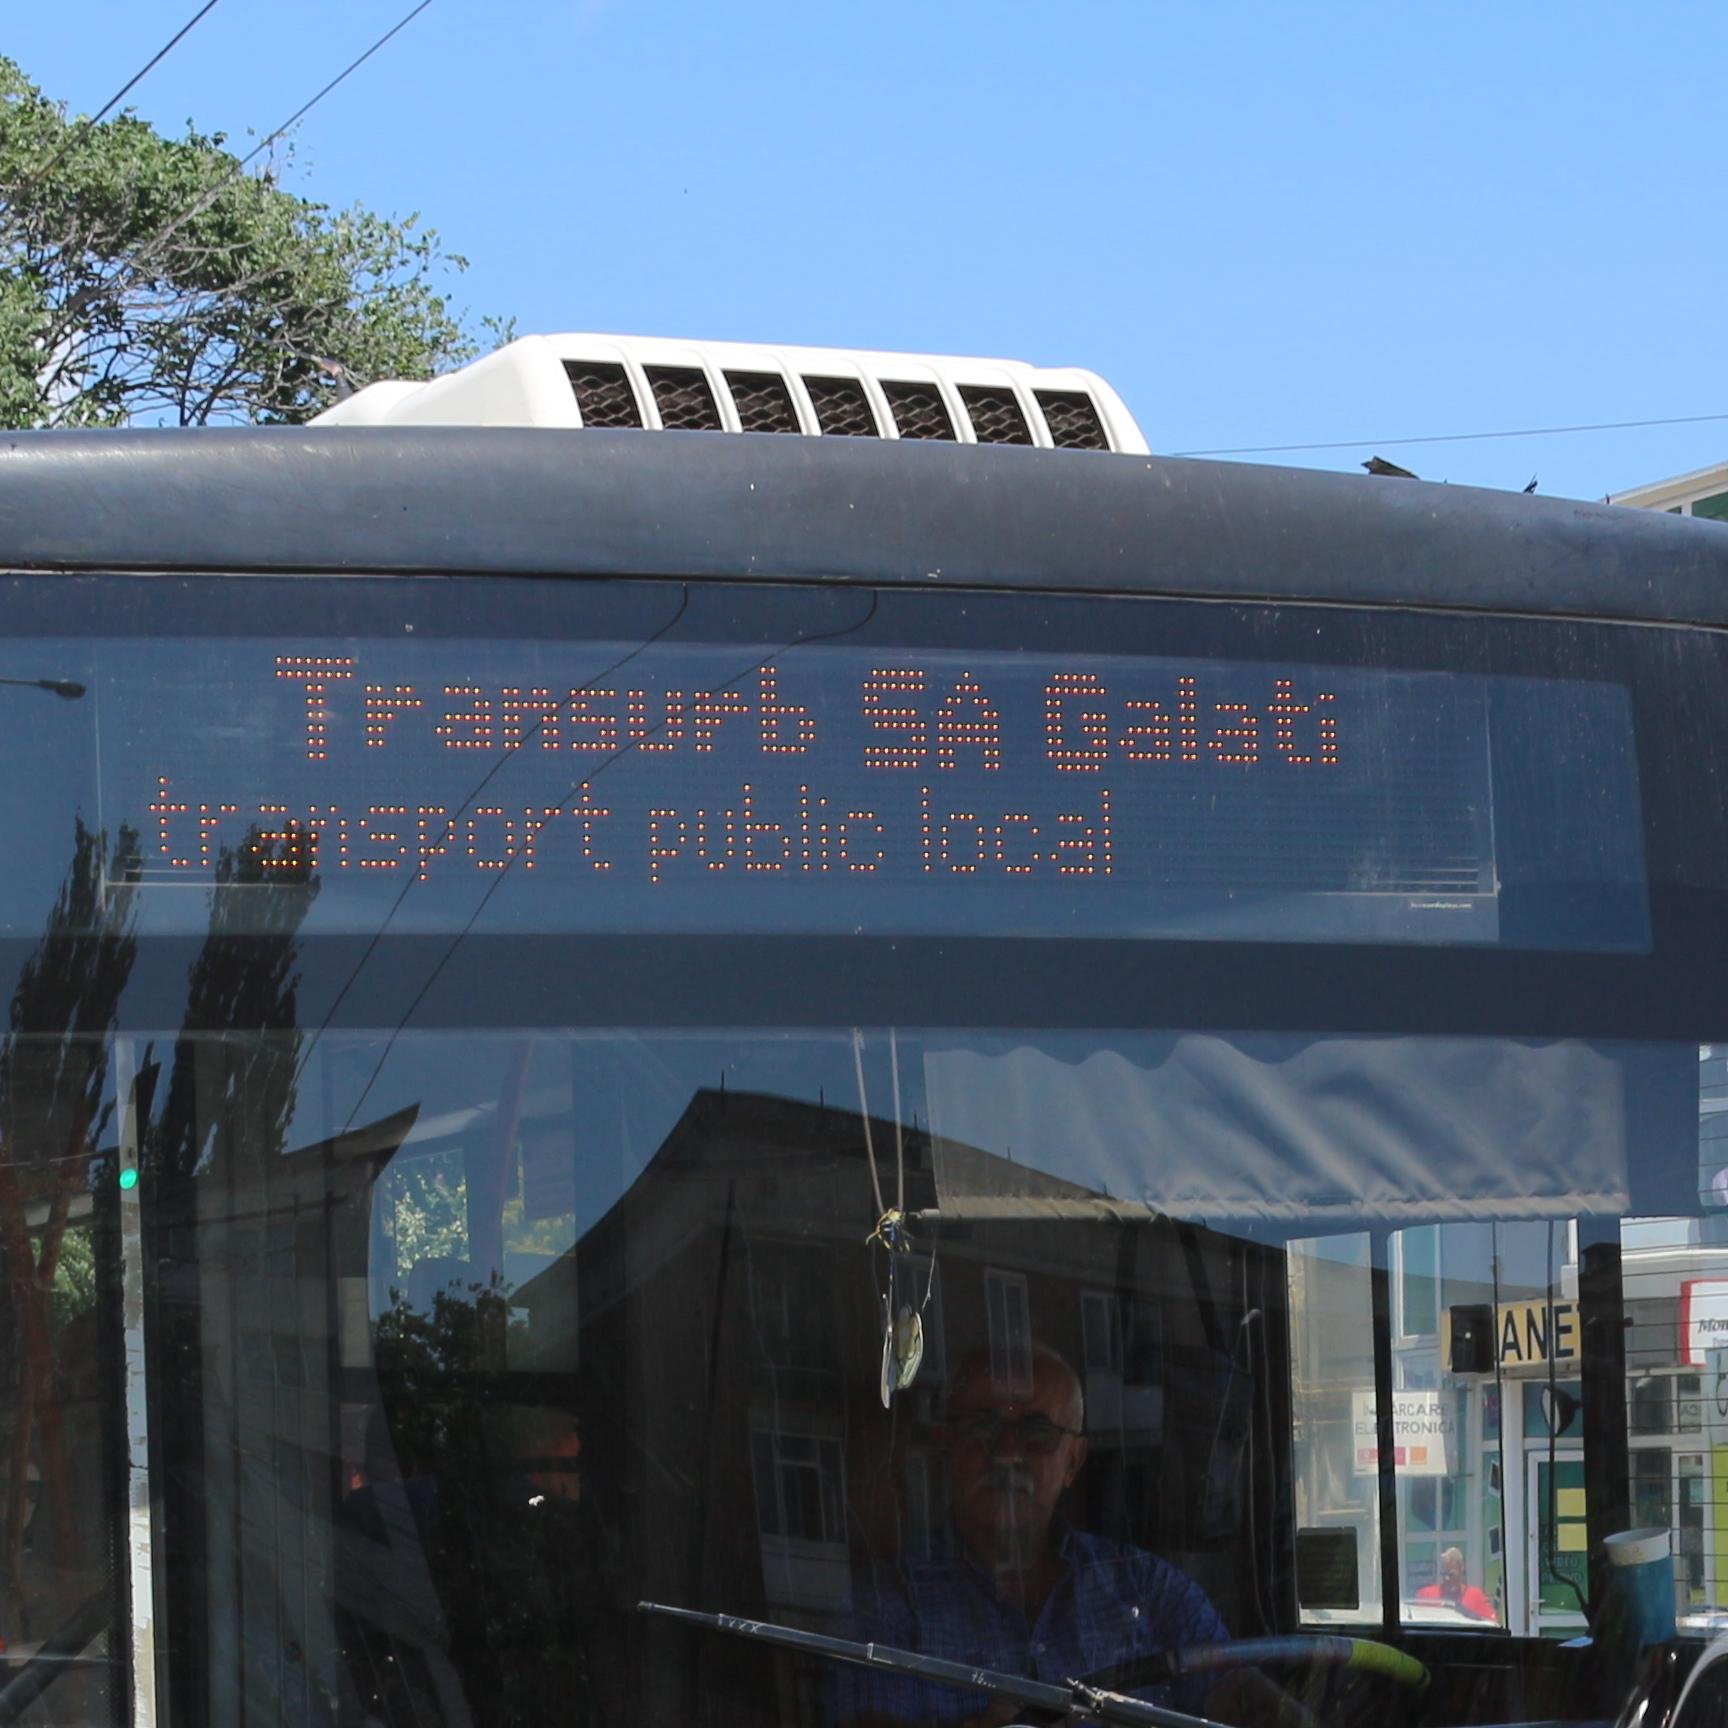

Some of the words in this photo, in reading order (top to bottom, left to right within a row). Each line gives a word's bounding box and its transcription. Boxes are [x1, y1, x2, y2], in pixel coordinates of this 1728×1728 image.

[274, 655, 816, 762] Transurb
[862, 668, 1001, 769] SA
[1043, 673, 1339, 771] Galati
[148, 775, 611, 881] transport
[649, 784, 885, 884] public
[920, 786, 1113, 875] local
